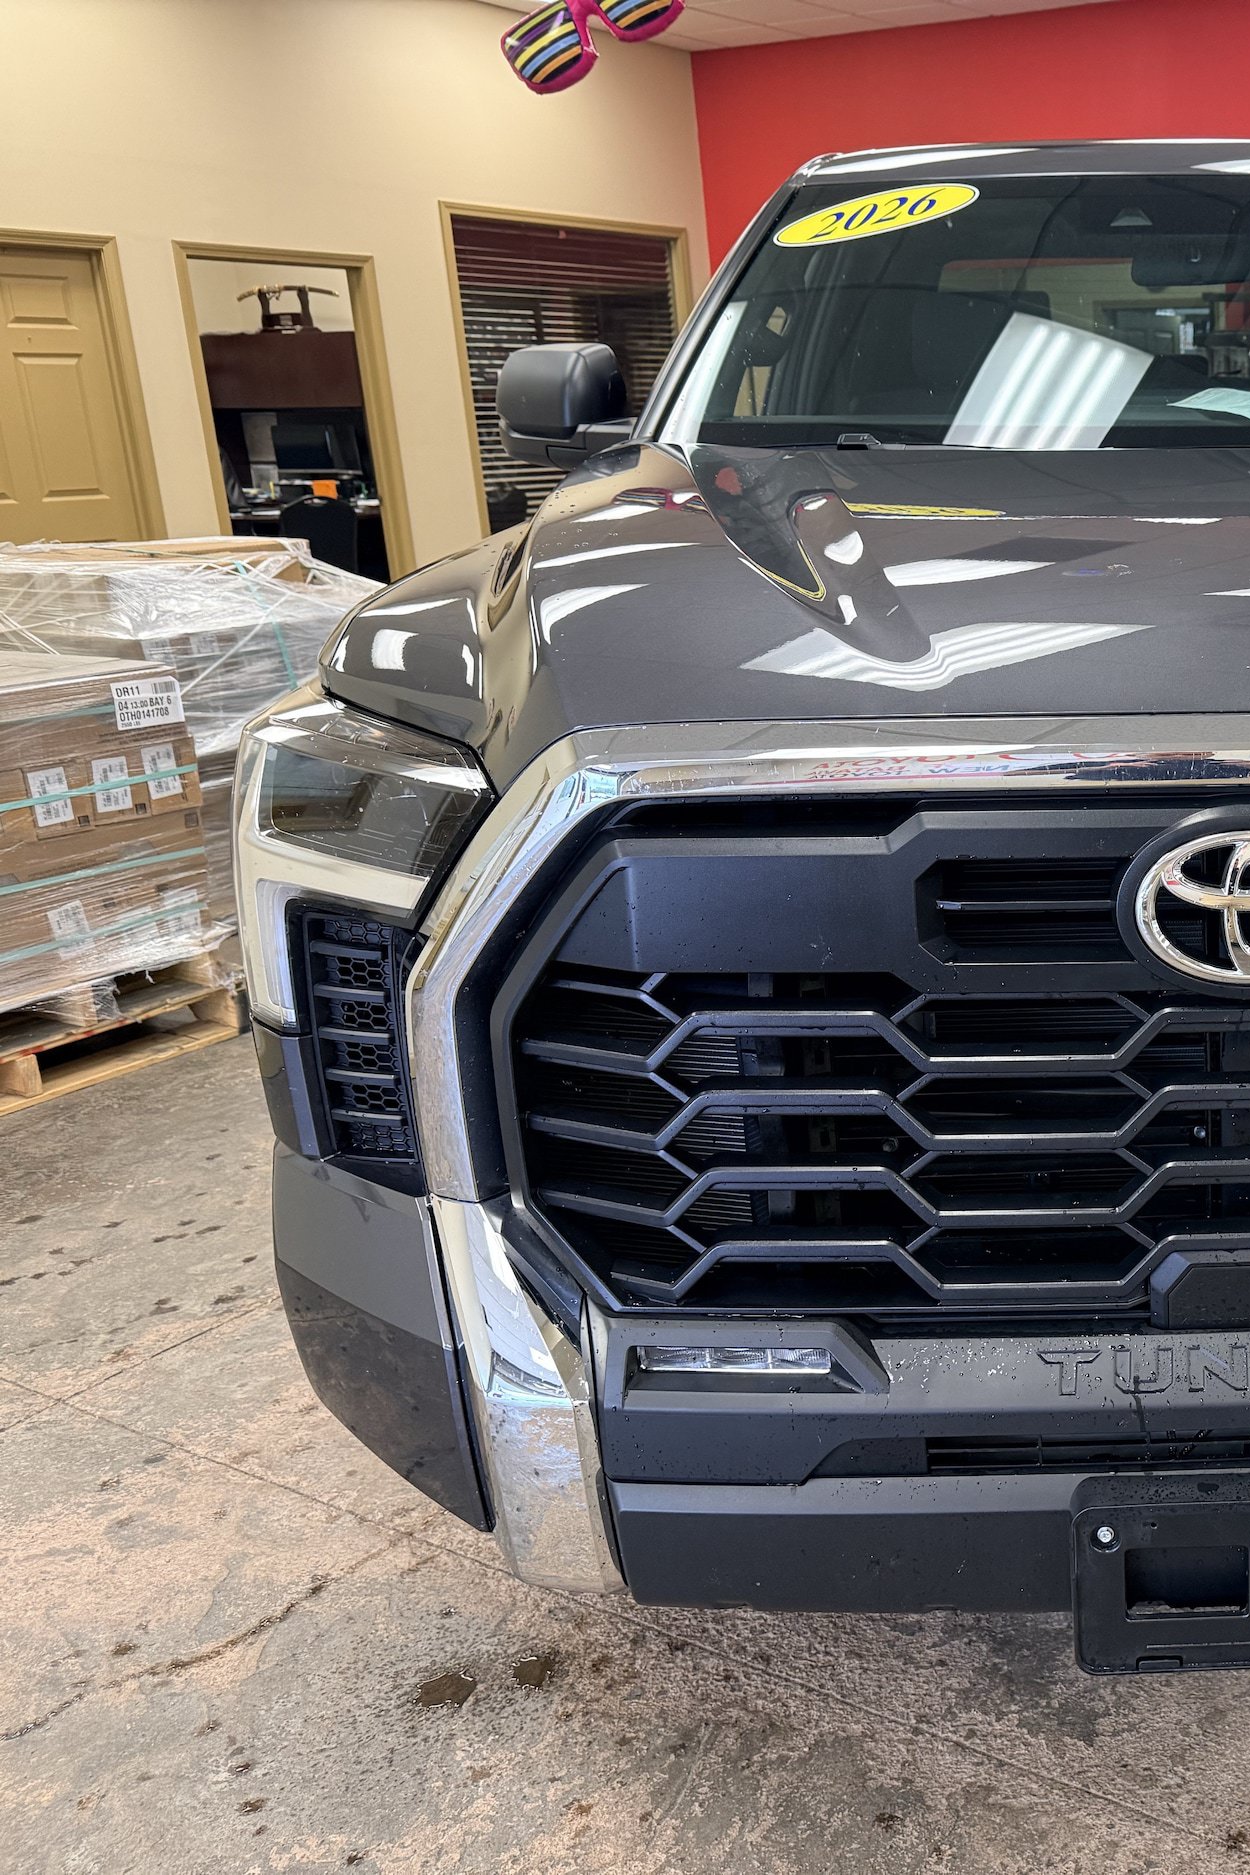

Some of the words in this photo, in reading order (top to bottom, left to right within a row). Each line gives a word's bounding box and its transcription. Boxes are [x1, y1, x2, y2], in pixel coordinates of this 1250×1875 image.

[806, 187, 947, 241] 2026
[115, 685, 141, 698] DR11
[118, 700, 129, 711] 04
[149, 695, 164, 707] BAY
